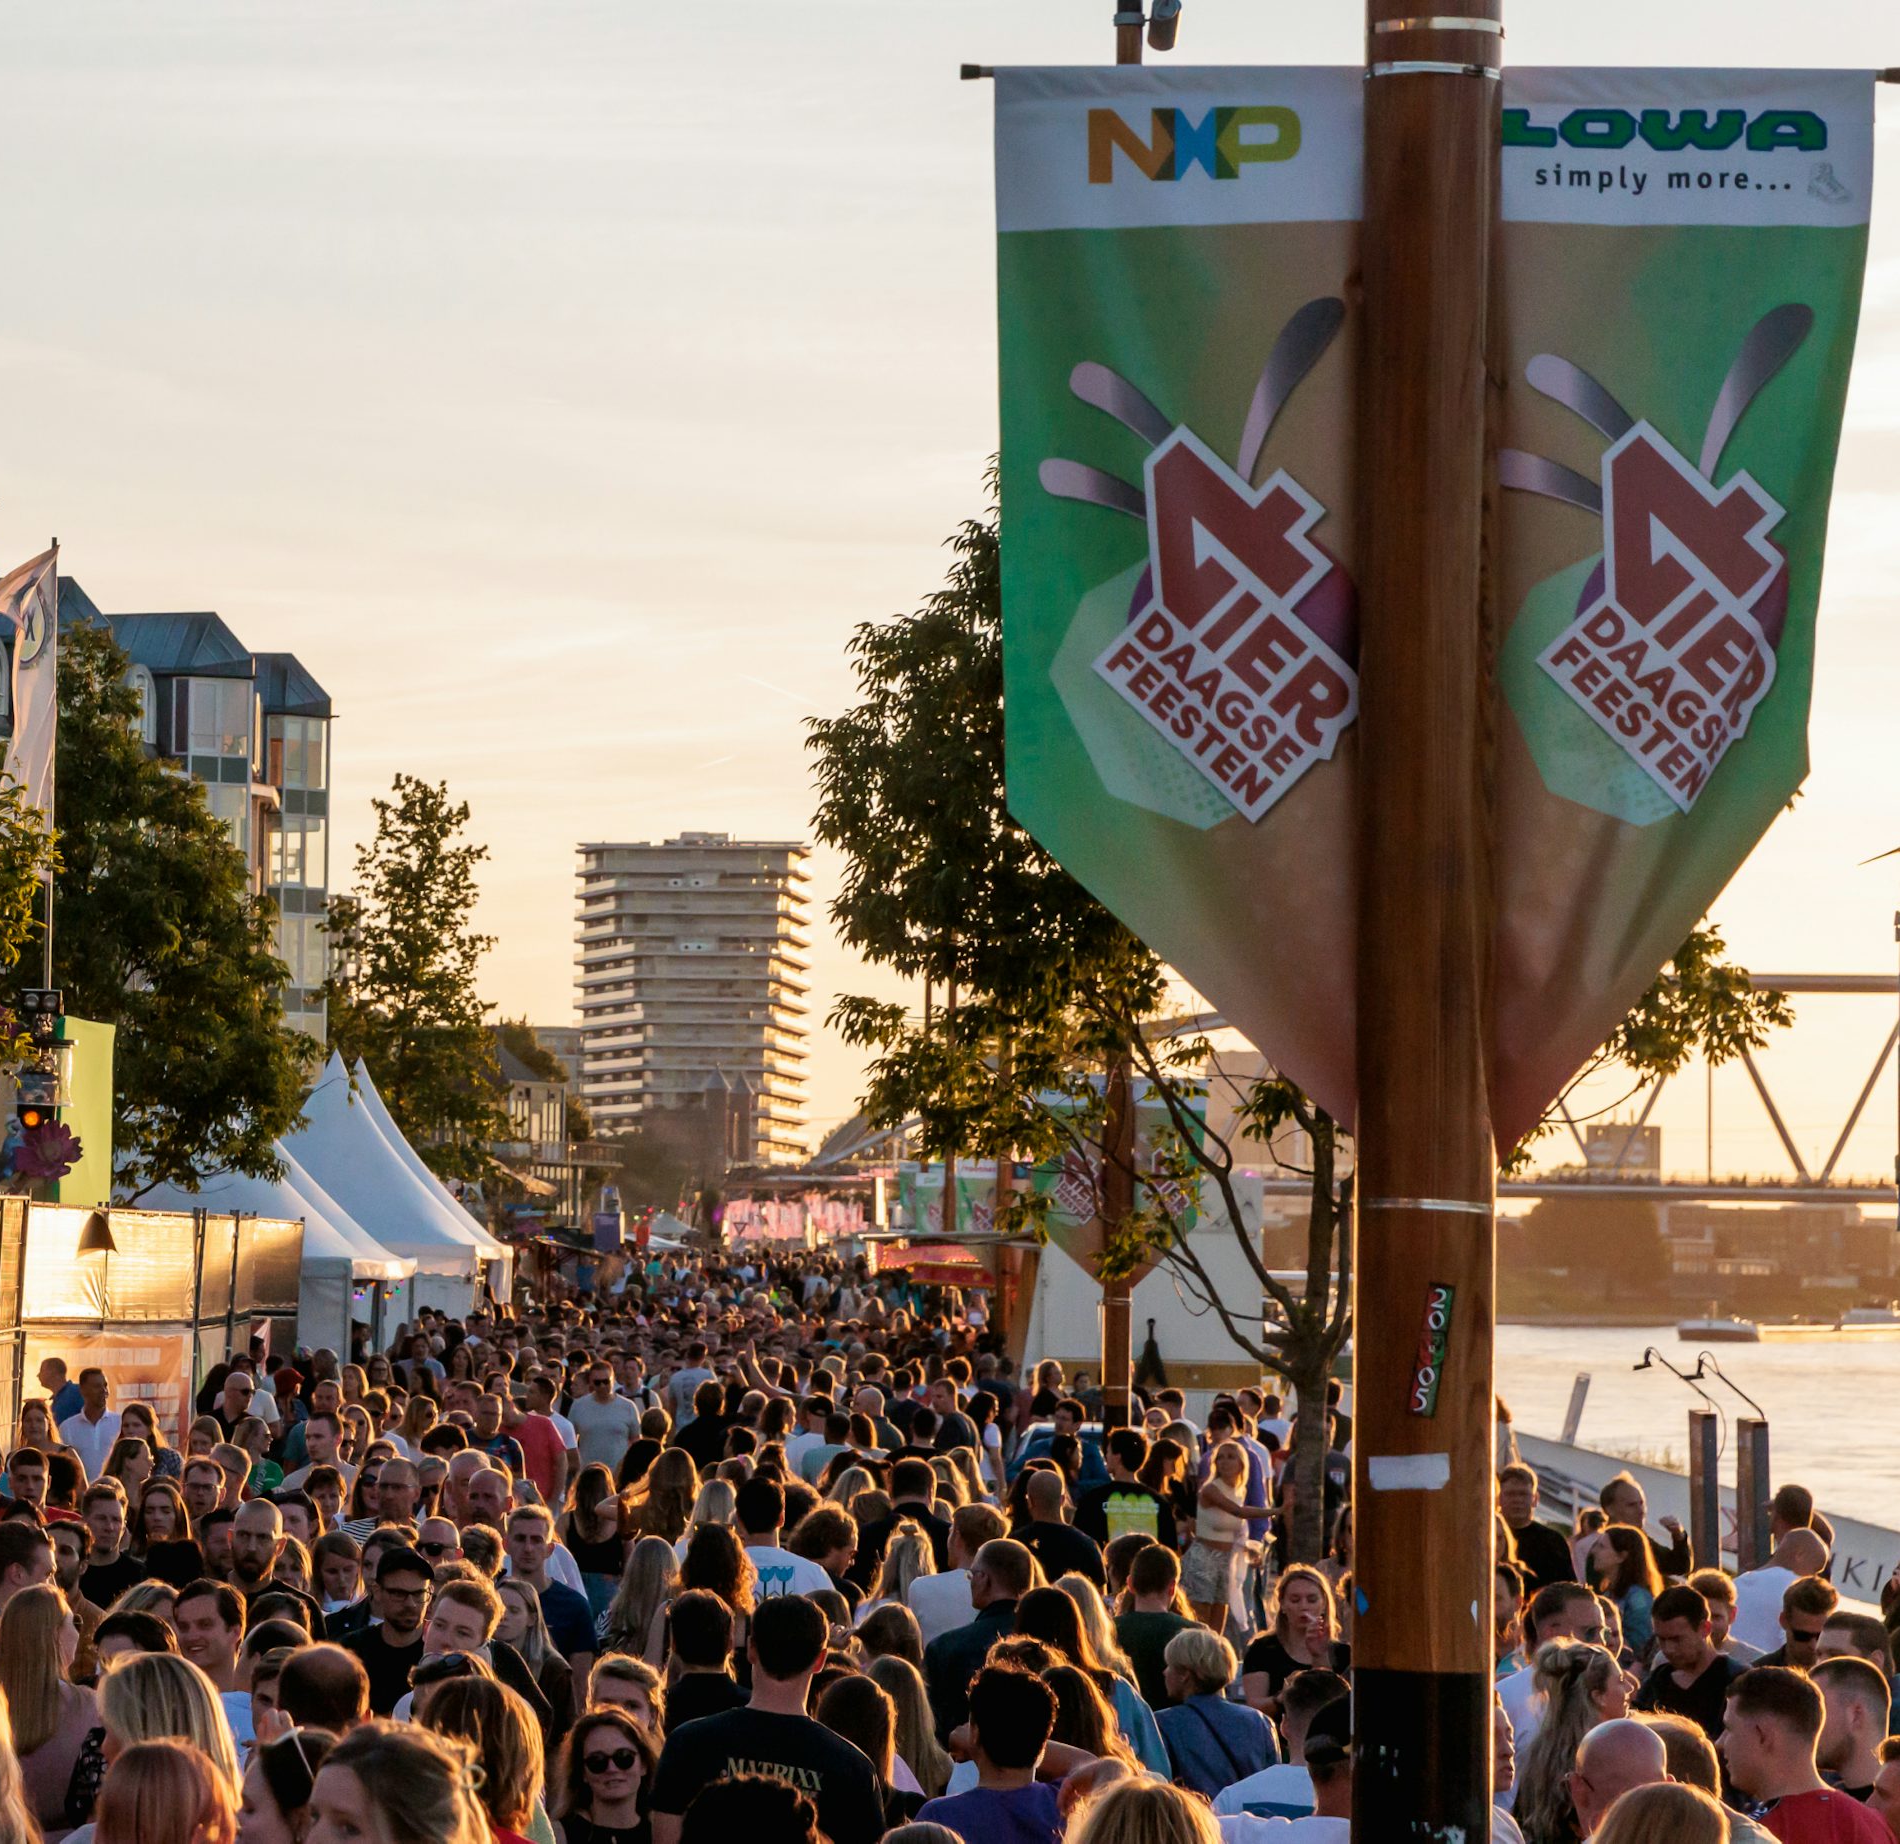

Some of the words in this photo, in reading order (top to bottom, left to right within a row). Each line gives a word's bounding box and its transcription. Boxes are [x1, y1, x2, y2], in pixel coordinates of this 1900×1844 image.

[1088, 106, 1302, 184] NXP
[1501, 108, 1828, 152] LOWA
[1536, 164, 1647, 195] simply
[1668, 169, 1791, 190] more...
[1106, 642, 1274, 807] FEESTEN
[1135, 609, 1305, 776] DAAGSE
[1551, 637, 1707, 801] FEESTEN
